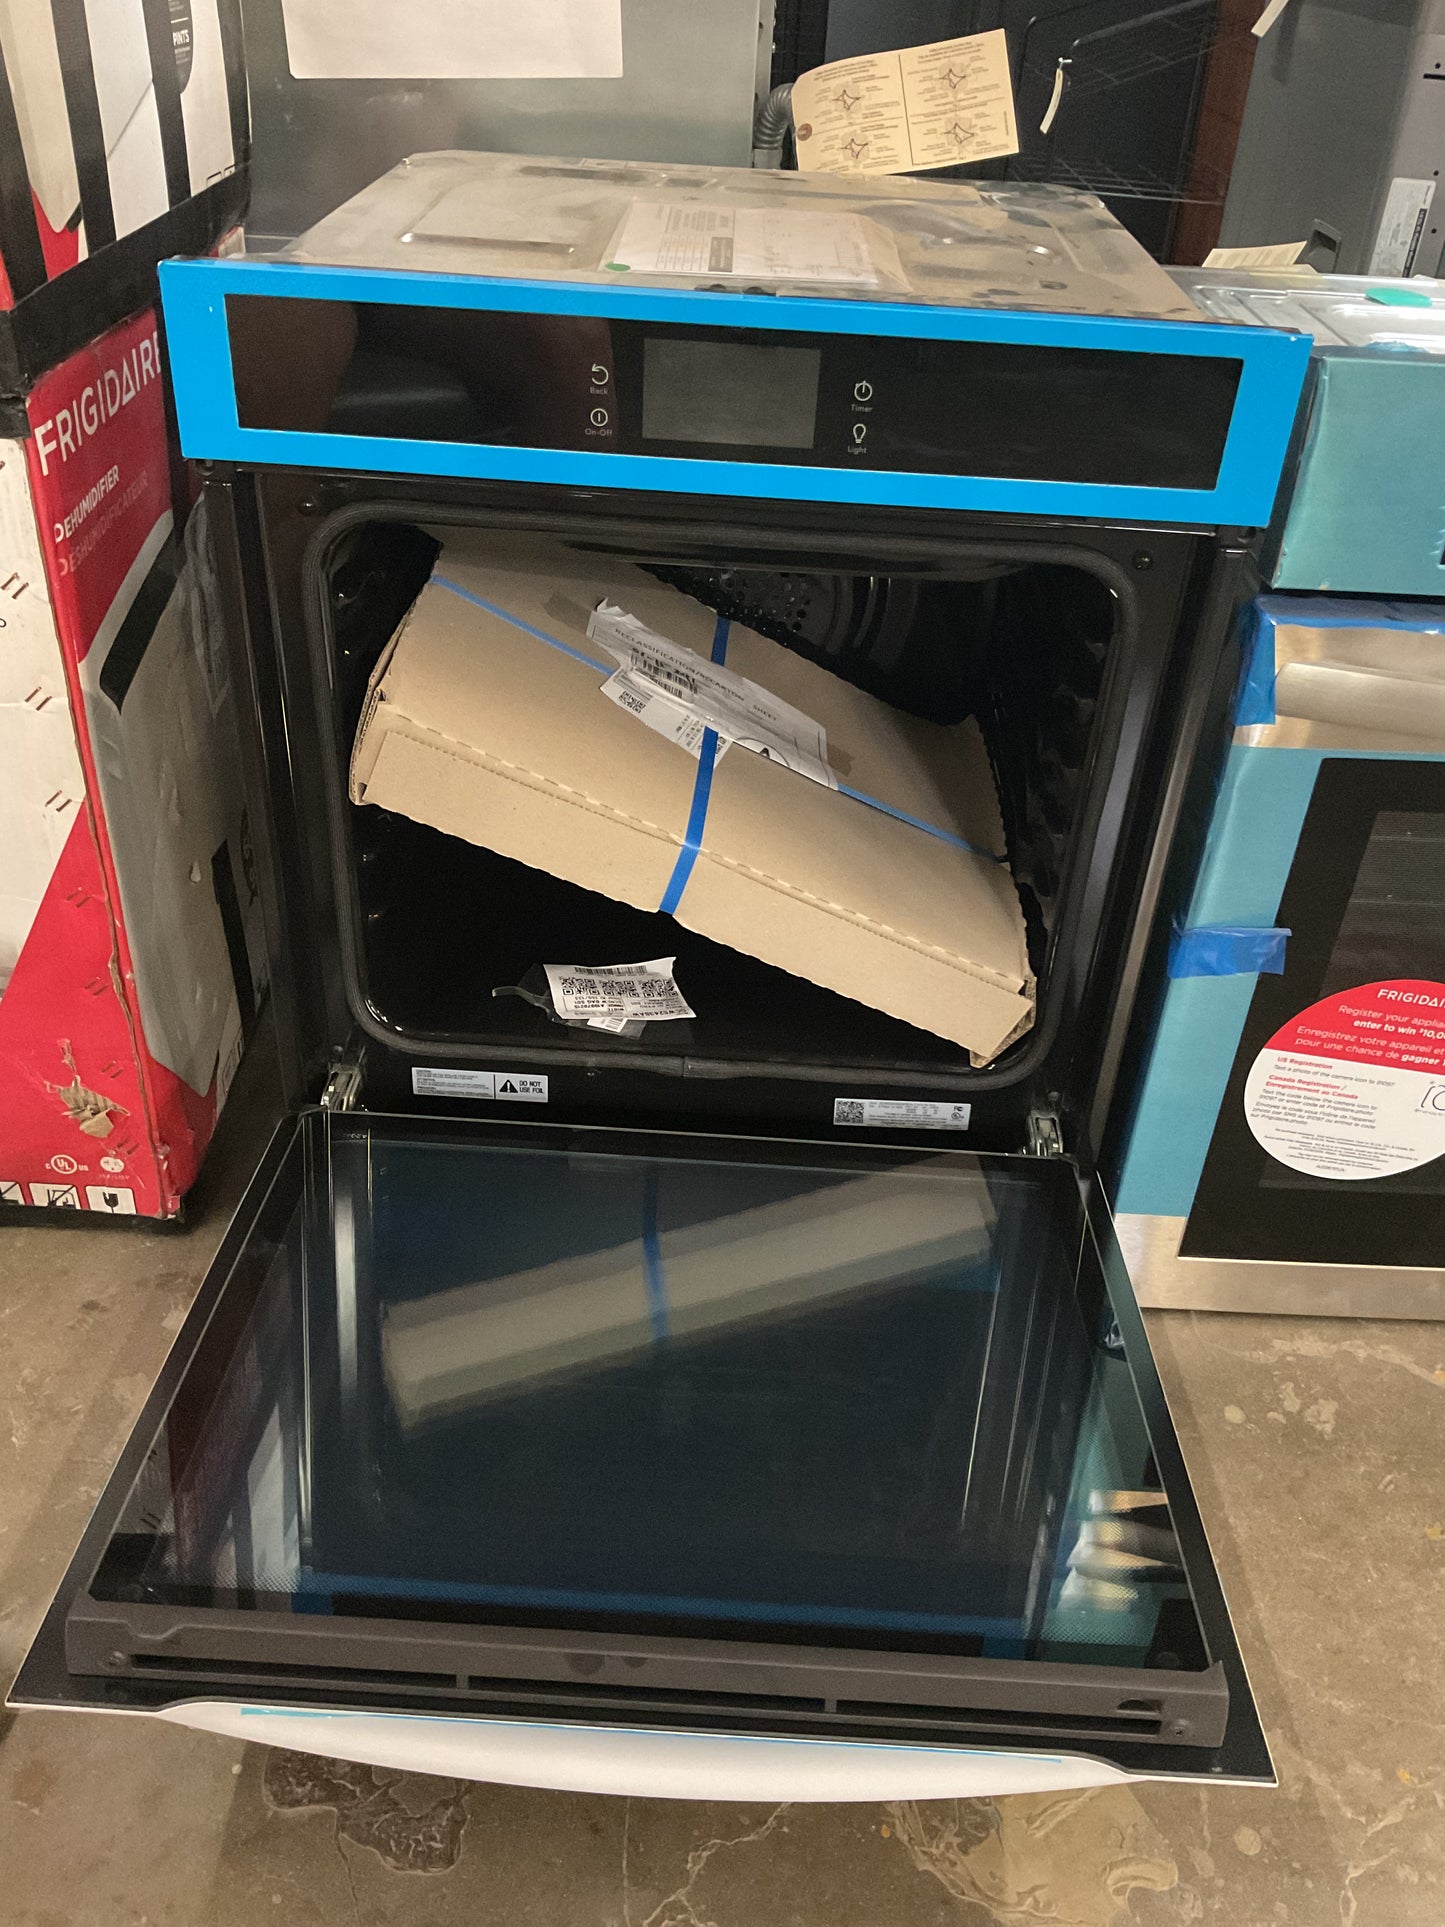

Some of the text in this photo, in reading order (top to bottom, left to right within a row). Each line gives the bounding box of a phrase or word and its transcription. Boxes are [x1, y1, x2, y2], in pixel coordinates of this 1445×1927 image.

[172, 29, 190, 46] PINTS
[590, 387, 608, 395] Back
[851, 404, 872, 412] Timer
[847, 446, 867, 455] Light
[54, 465, 120, 544] DEHUMIDIFIER
[752, 704, 777, 721] SHEET
[1377, 988, 1445, 1008] FRIGIDAI
[1338, 1005, 1383, 1019] Register
[1384, 1014, 1410, 1022] your
[1353, 1020, 1445, 1040] enter to win $10,0
[1296, 1025, 1358, 1042] Enregistrez
[1360, 1037, 1388, 1047] votre
[1389, 1041, 1433, 1053] appareil
[1294, 1038, 1321, 1047] pour
[1323, 1042, 1344, 1051] une
[1345, 1045, 1383, 1057] chance
[1385, 1051, 1400, 1060] de
[1401, 1054, 1440, 1066] gagner
[1289, 1058, 1333, 1069] Registration
[529, 1080, 542, 1088] NOT
[1265, 1081, 1320, 1093] Enregistrement
[1331, 1091, 1359, 1099] Canada
[1297, 1079, 1340, 1089] Registration
[56, 1158, 72, 1170] UL
